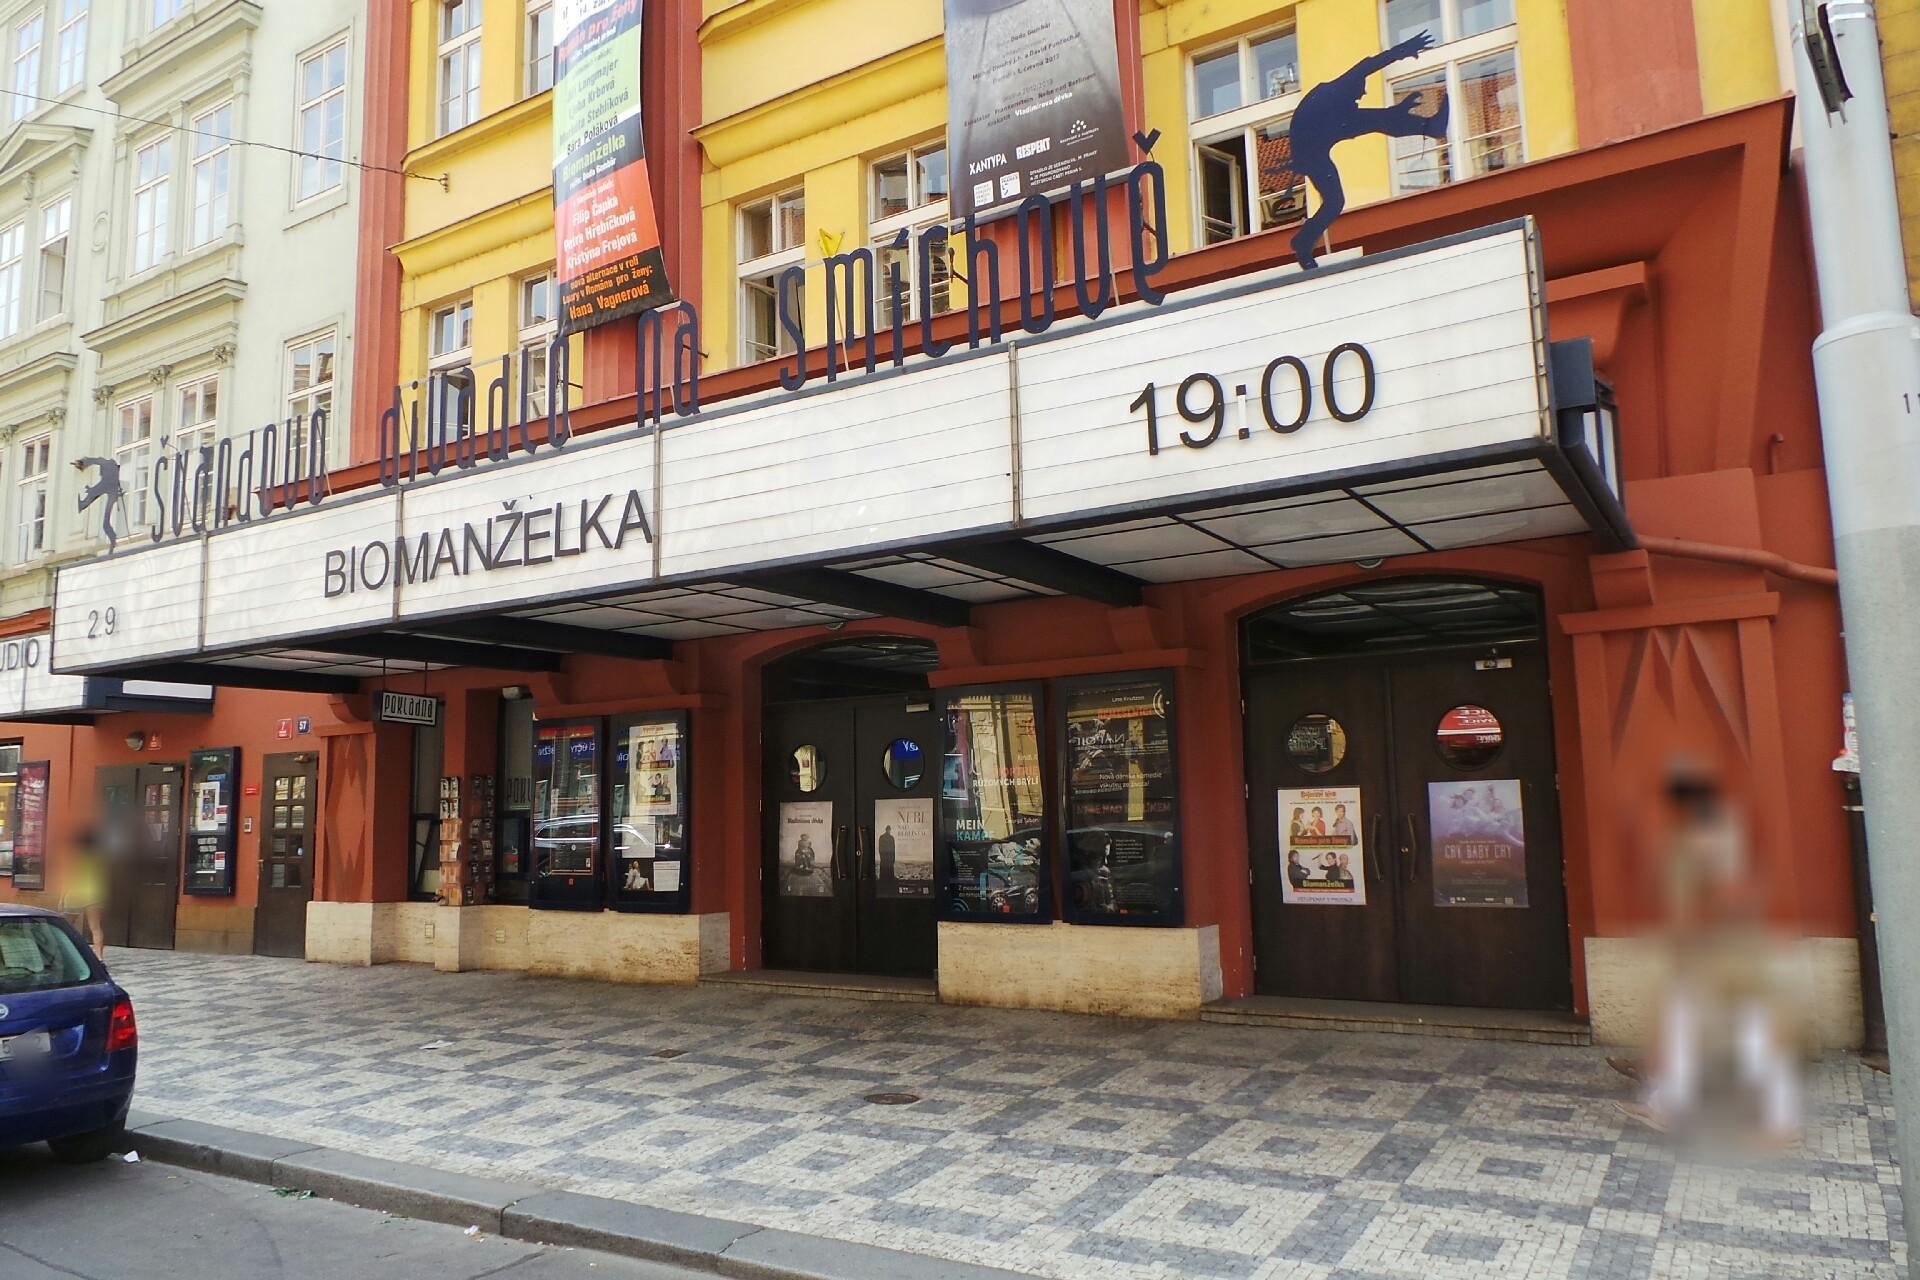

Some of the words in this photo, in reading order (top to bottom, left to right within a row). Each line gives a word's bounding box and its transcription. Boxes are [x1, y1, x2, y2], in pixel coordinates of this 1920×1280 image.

[583, 111, 618, 142] Poláková
[969, 153, 1007, 176] XANTYPA
[1016, 137, 1051, 161] RESPEKT
[572, 209, 590, 225] Filip
[592, 195, 619, 216] Čapka
[563, 232, 584, 253] Petra
[585, 205, 637, 241] Hřebíčková
[566, 246, 601, 269] Kristýna
[602, 227, 639, 253] Frejová
[585, 279, 613, 296] Románu
[616, 273, 629, 286] pro
[631, 264, 653, 279] ženy:
[586, 265, 618, 283] alternace
[626, 255, 639, 268] roli
[569, 302, 594, 320] Hana
[596, 279, 651, 310] Vagnerová
[636, 300, 701, 429] na
[1130, 342, 1377, 456] 19:00
[324, 488, 654, 599] BIOMANŽELKA
[299, 720, 307, 731] 57
[956, 819, 985, 831] MEIN
[1444, 844, 1461, 858] CRY
[1466, 844, 1489, 858] BABY
[1494, 844, 1511, 858] CRY
